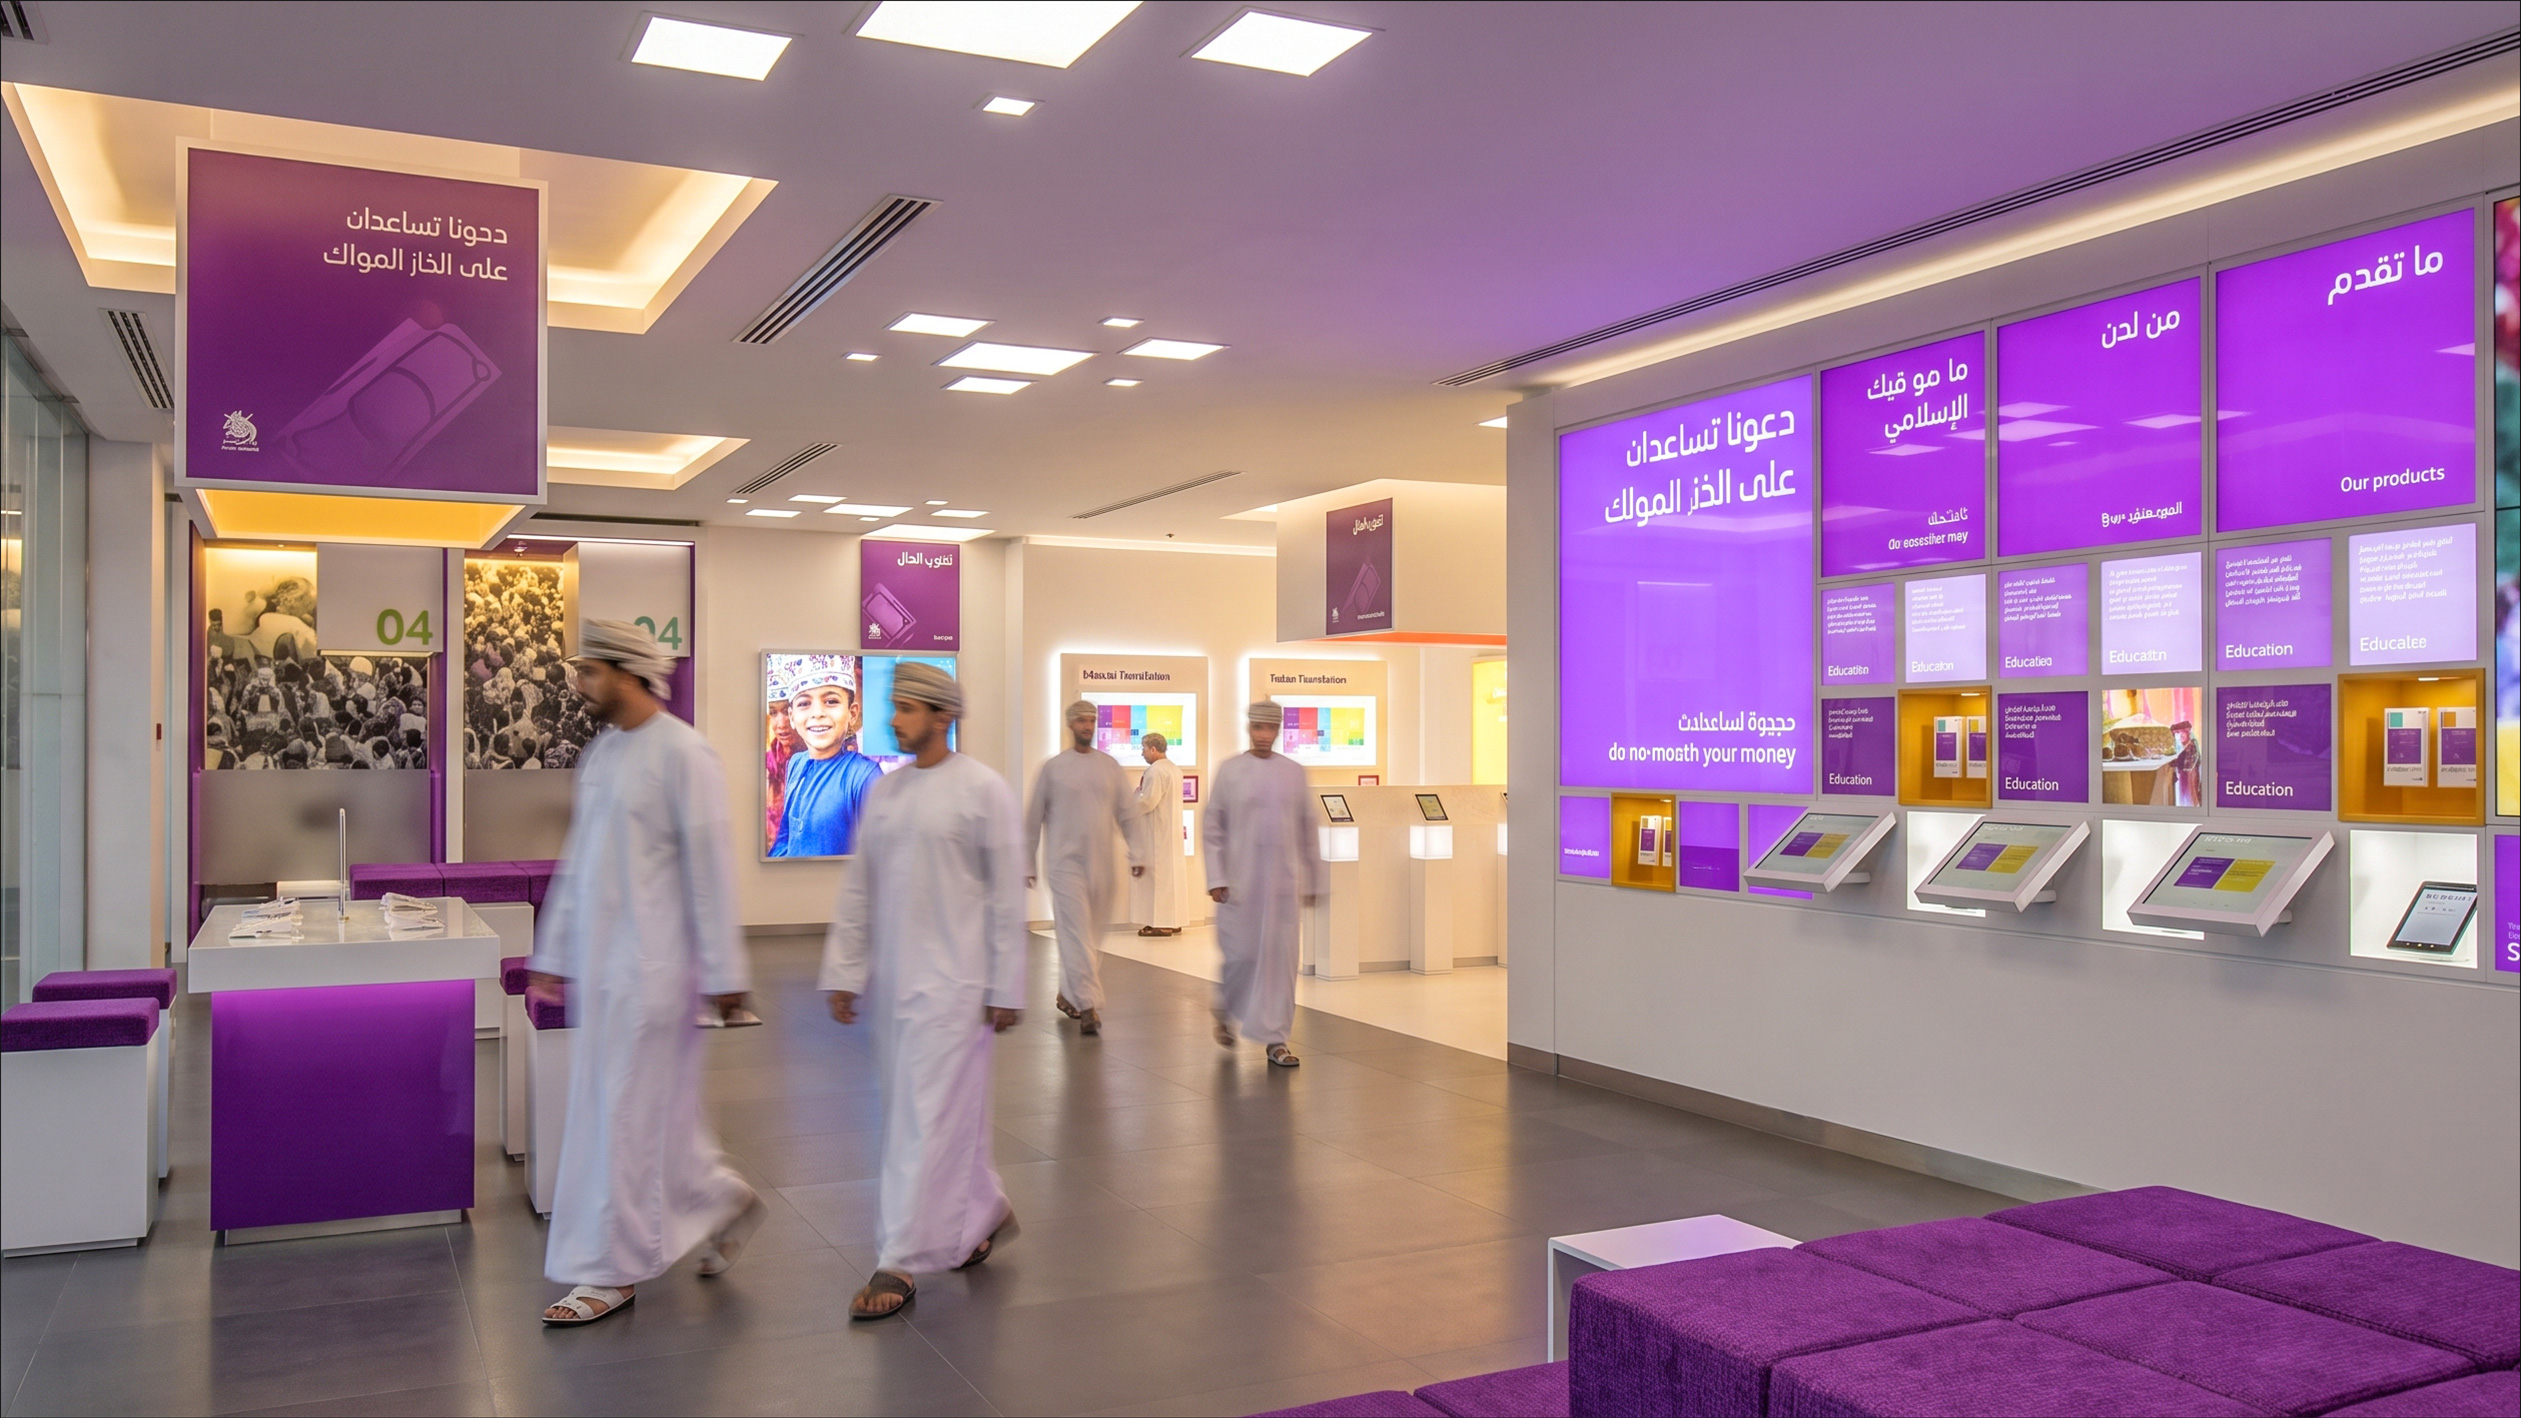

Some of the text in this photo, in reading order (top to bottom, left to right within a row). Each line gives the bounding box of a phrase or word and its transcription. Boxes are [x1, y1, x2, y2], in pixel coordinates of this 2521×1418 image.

[346, 206, 442, 237] تساعدان
[409, 250, 452, 277] الخاز
[459, 257, 508, 281] على
[2327, 244, 2444, 306] ما تقدم
[2101, 310, 2180, 349] من لدن
[1948, 357, 1968, 382] ما
[1884, 392, 1968, 444] الإسلامي
[1626, 410, 1795, 467] دعونا تساعدان
[1739, 459, 1796, 502] على
[2340, 466, 2446, 493] Our products
[376, 608, 434, 647] 04
[2225, 643, 2294, 659] Education
[1608, 741, 1626, 761] do
[1702, 746, 1738, 768] your
[1740, 746, 1797, 770] money
[1828, 773, 1873, 786] Education
[2005, 776, 2060, 791] Education
[2225, 780, 2294, 797] Education
